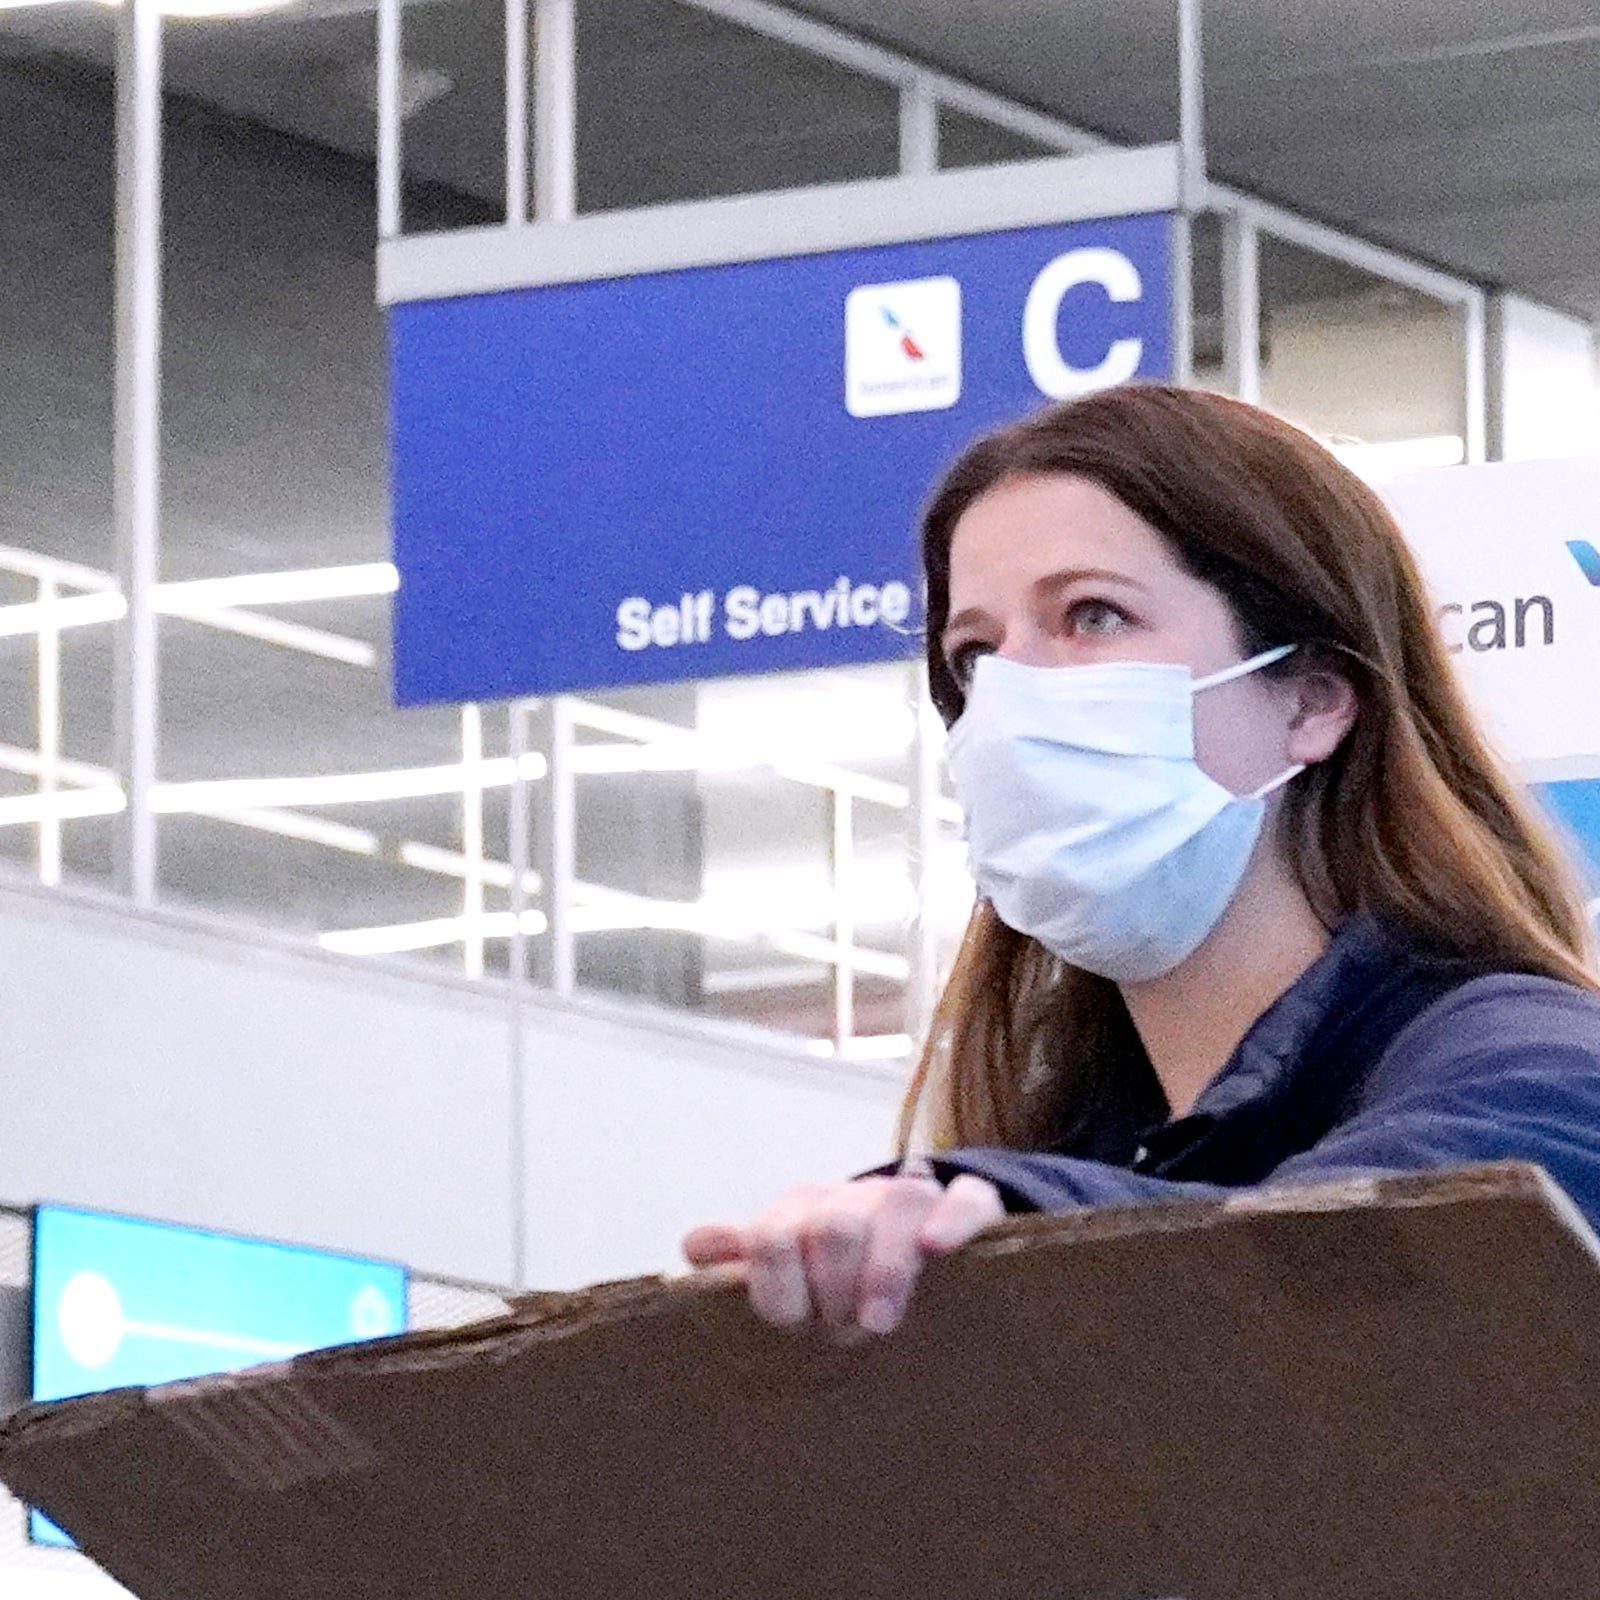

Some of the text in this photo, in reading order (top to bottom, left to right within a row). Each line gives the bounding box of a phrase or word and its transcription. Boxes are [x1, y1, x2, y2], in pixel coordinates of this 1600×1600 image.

[1024, 246, 1142, 401] C
[616, 576, 911, 652] Self Service
